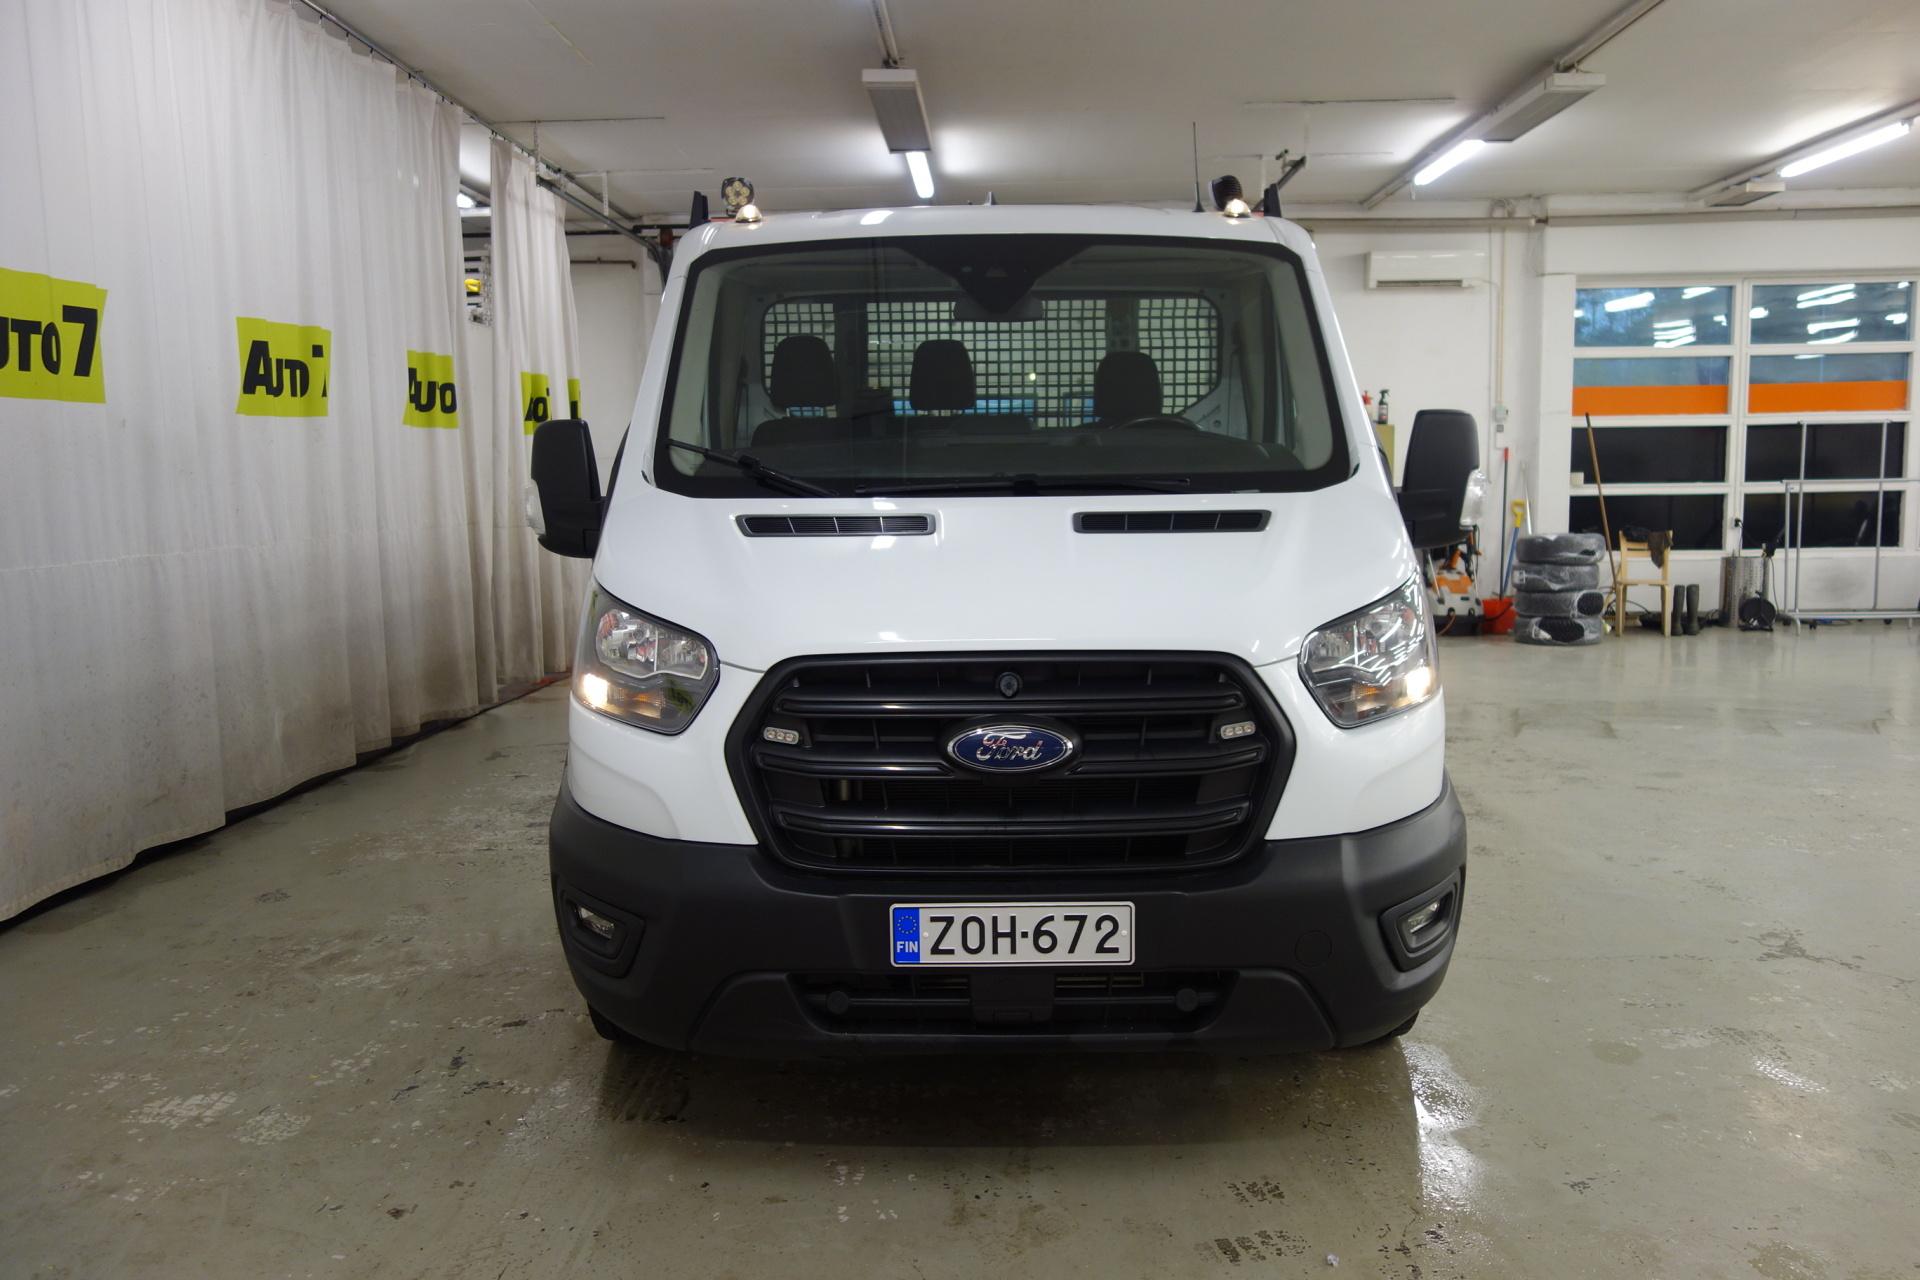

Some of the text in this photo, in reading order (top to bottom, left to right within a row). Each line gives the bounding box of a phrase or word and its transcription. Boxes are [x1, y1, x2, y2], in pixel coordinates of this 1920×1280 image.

[62, 304, 98, 377] 7
[976, 730, 1042, 760] Ford
[896, 915, 1120, 955] FIN ZOH-672
